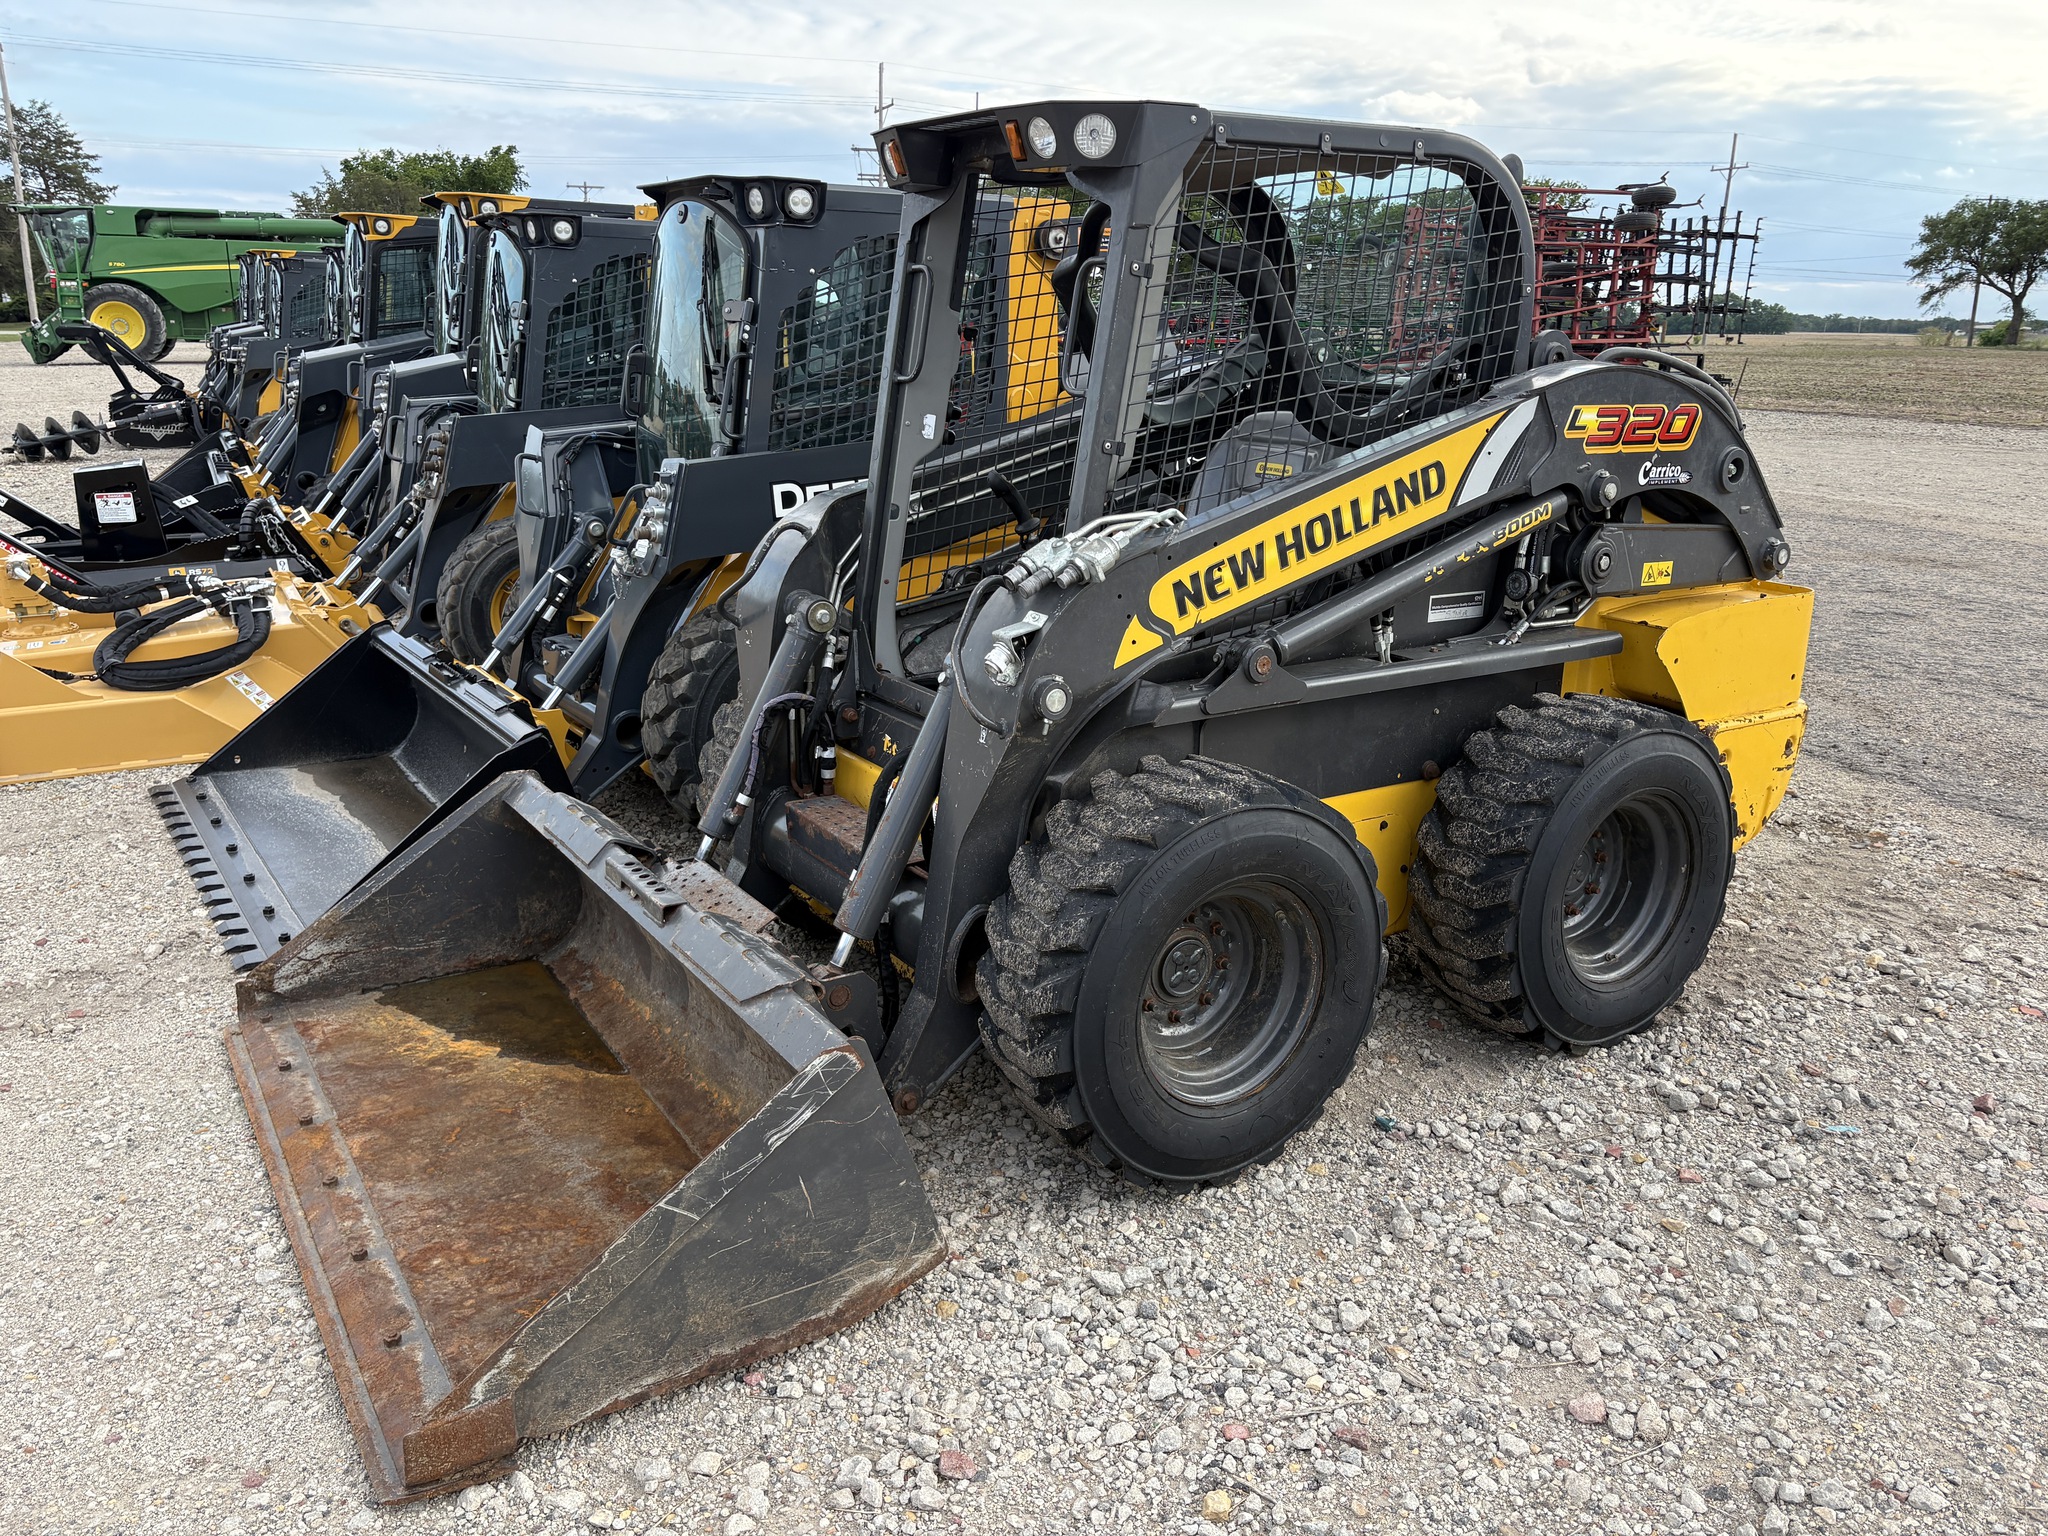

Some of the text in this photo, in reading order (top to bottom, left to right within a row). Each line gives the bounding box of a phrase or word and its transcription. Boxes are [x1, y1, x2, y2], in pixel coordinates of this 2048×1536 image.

[1564, 404, 1702, 453] L320
[1638, 461, 1682, 486] Carrico
[1172, 540, 1265, 618] NEW
[1275, 460, 1446, 571] HOLLAND
[188, 568, 214, 576] RS72
